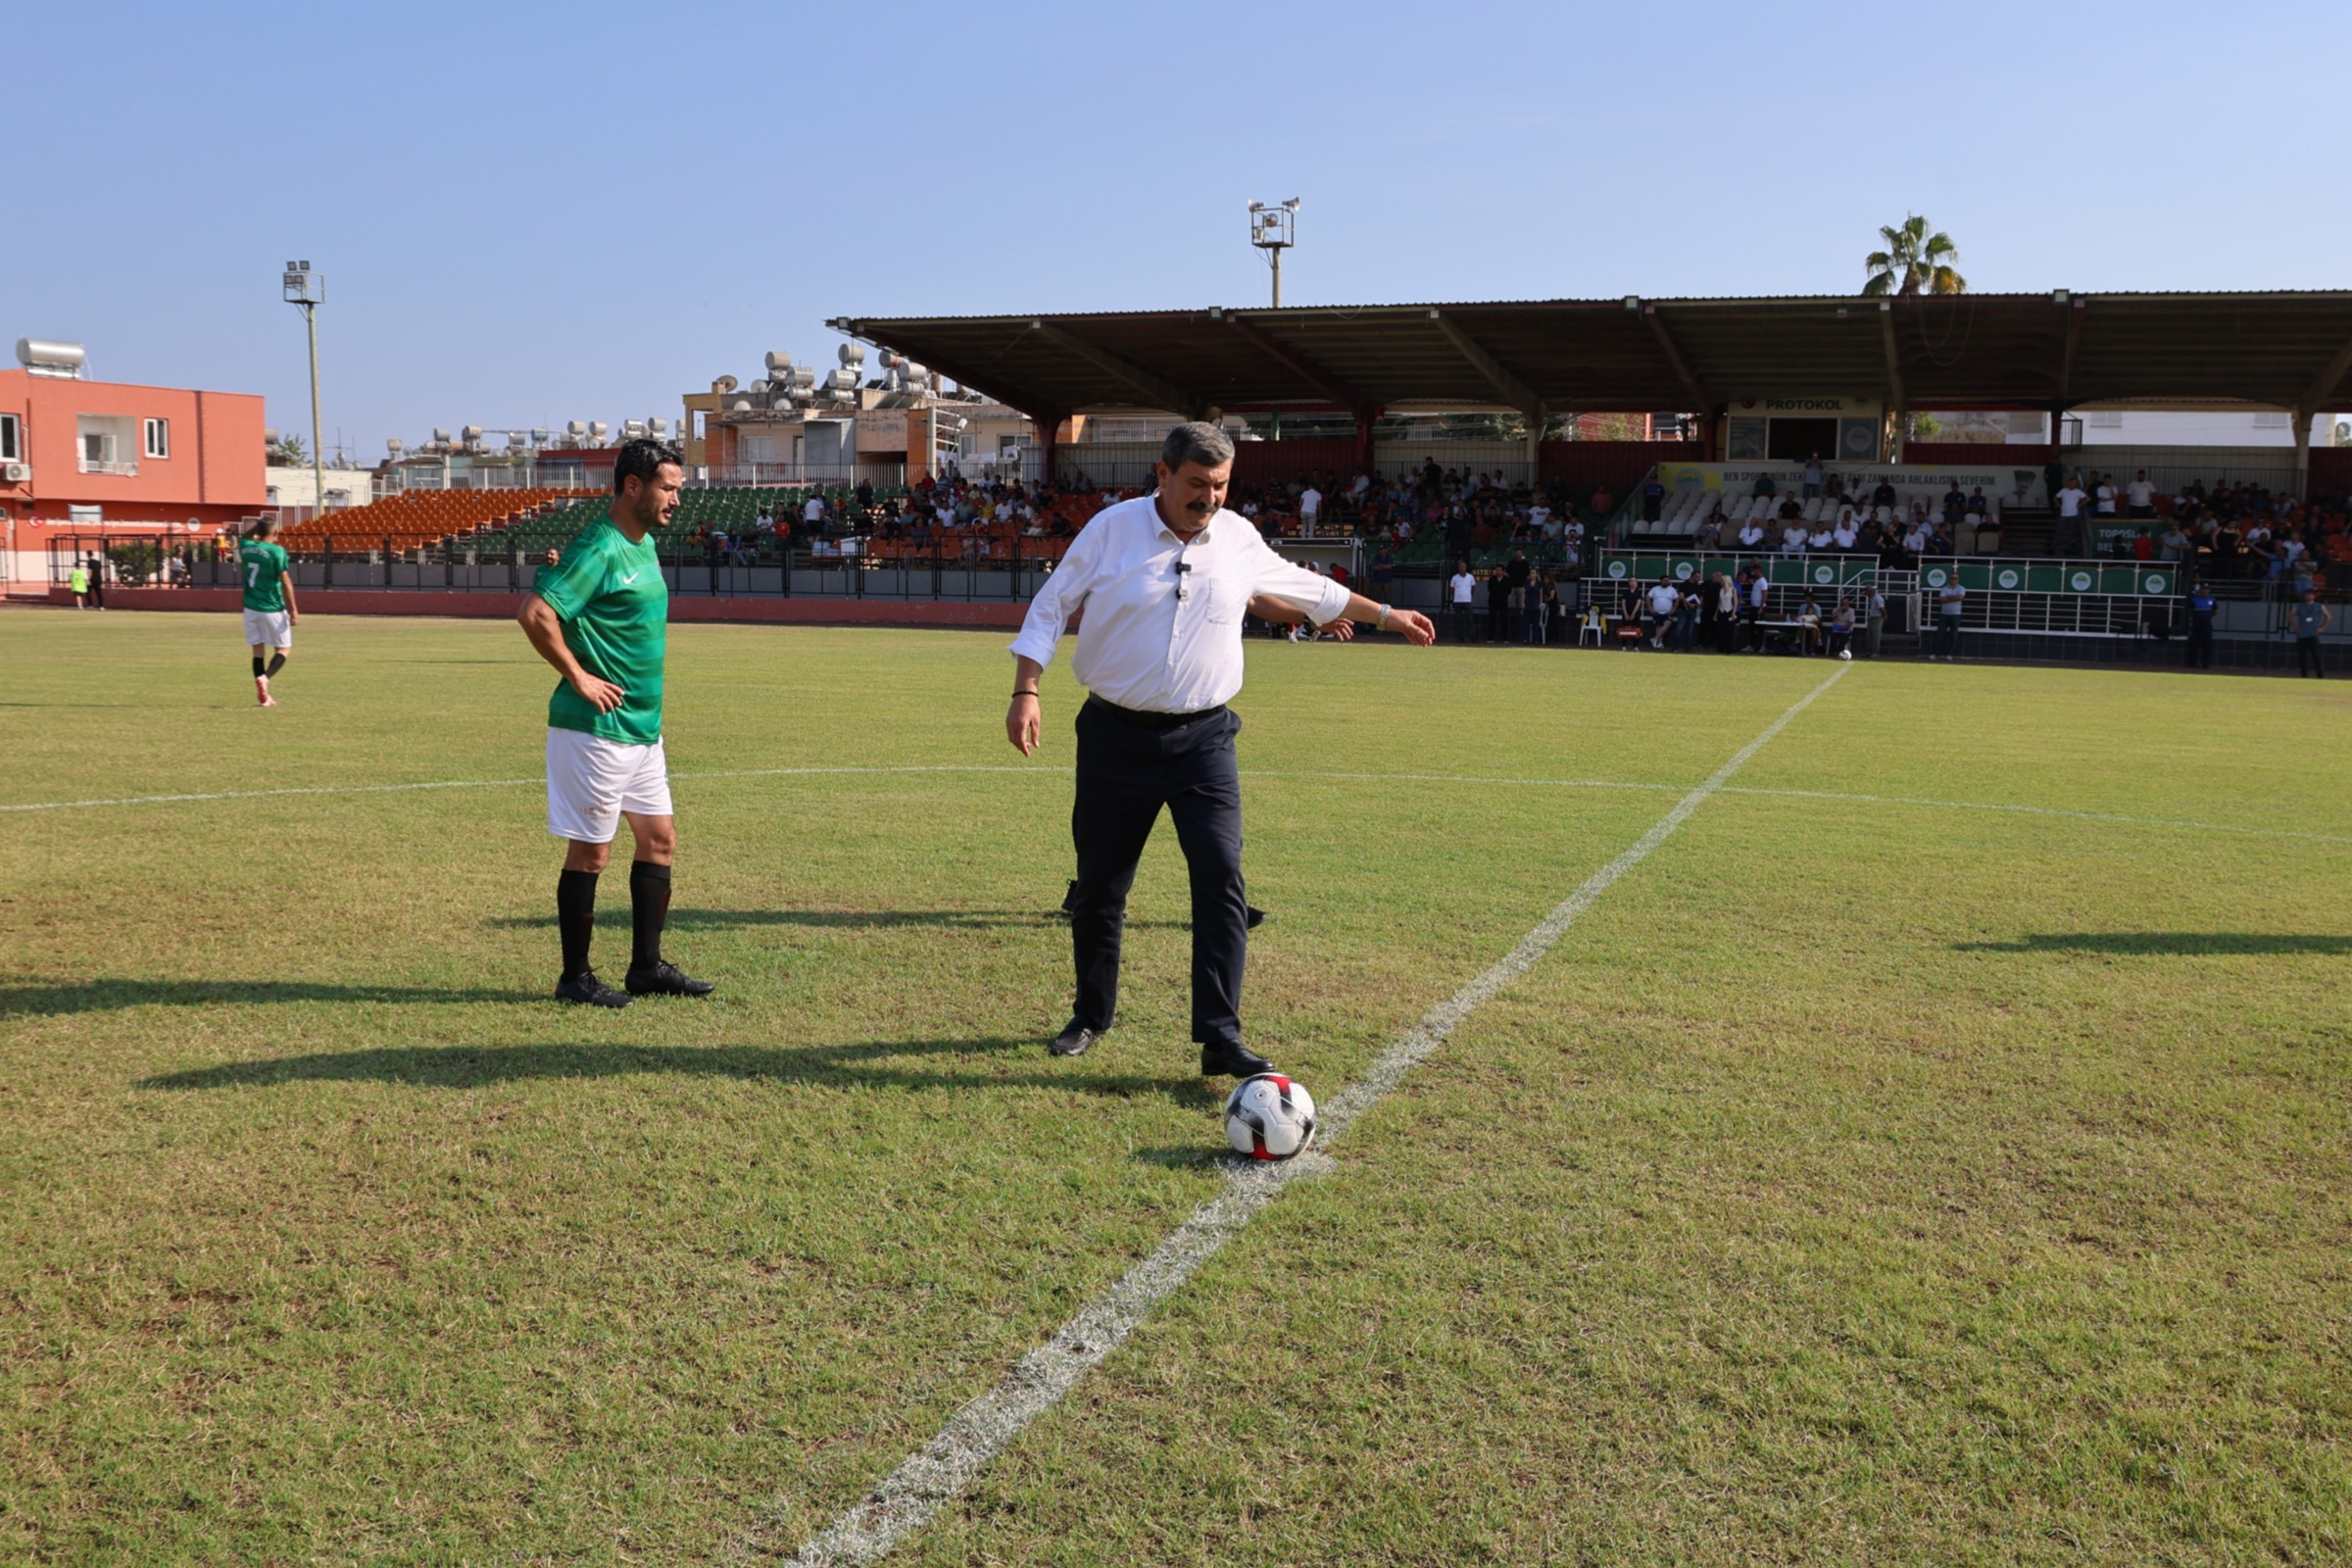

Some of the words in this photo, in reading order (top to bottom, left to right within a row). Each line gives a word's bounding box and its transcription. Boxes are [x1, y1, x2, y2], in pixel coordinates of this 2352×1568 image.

[1766, 399, 1842, 410] PROTOKOL
[1724, 471, 1739, 481] BEN
[247, 563, 260, 588] 7
